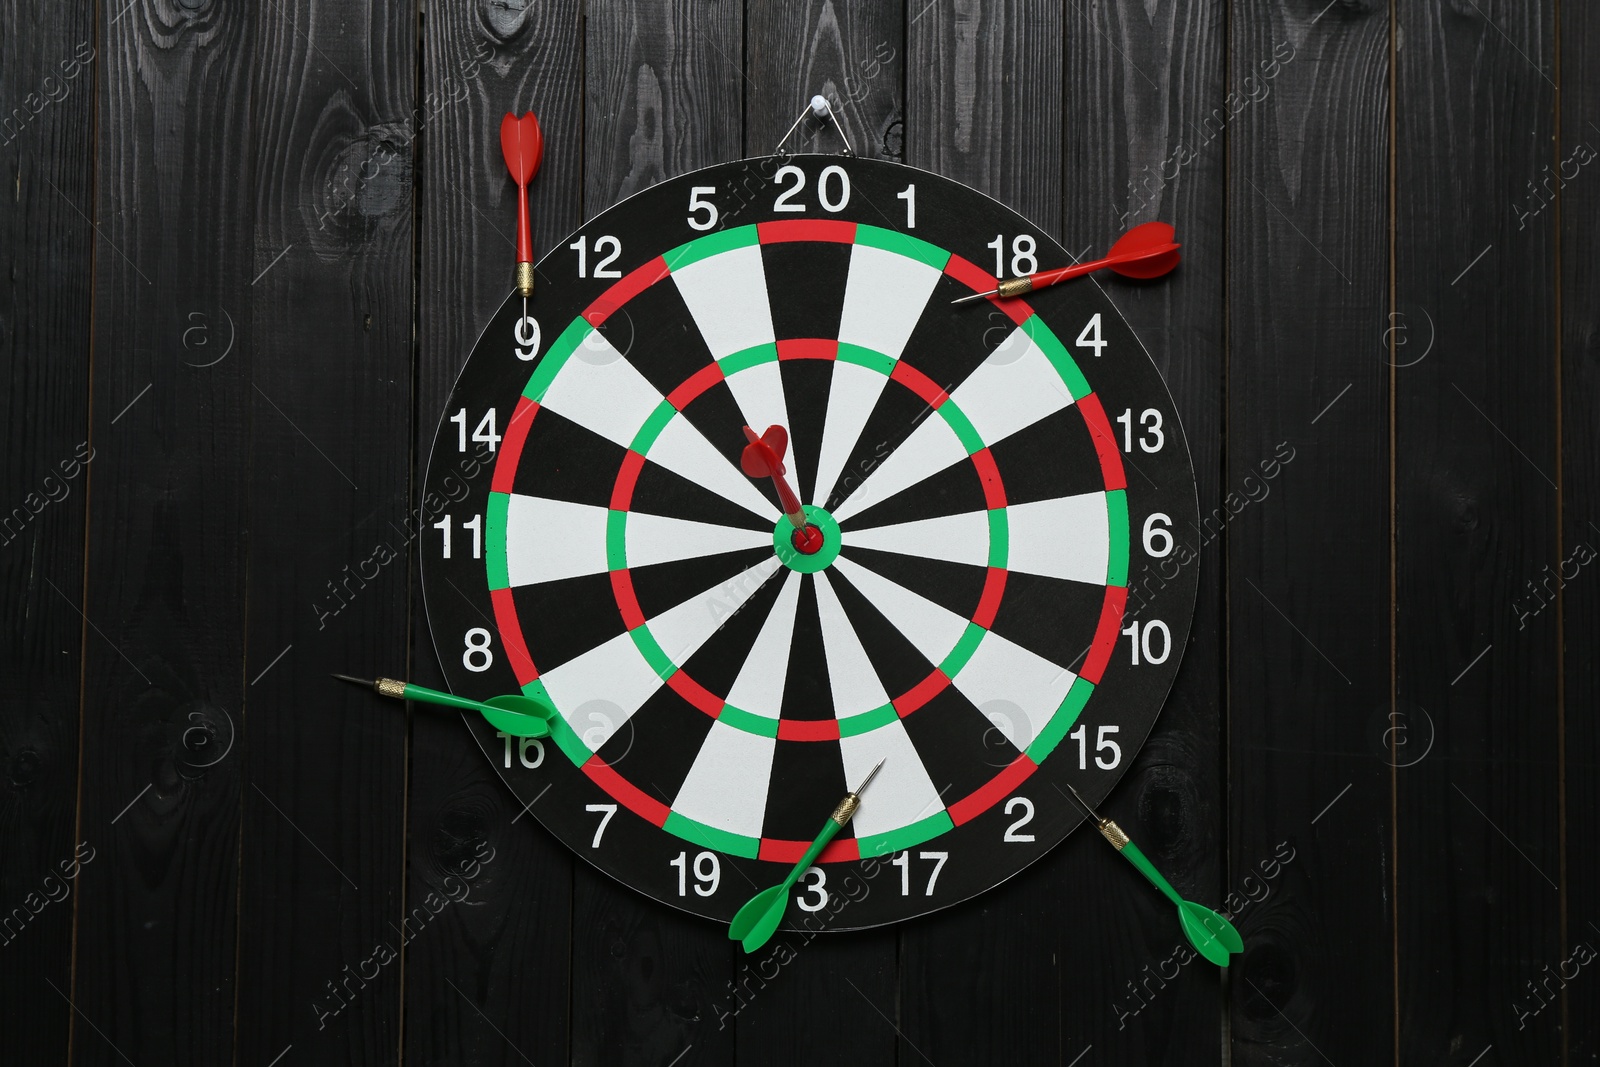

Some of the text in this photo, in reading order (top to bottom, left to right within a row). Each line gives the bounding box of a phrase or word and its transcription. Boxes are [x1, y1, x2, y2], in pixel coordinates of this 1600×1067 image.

[688, 187, 718, 230] 5
[774, 166, 850, 212] 20
[897, 184, 915, 228] 1
[570, 236, 621, 278] 12
[988, 235, 1037, 278] 18
[514, 316, 541, 361] 9
[1076, 314, 1107, 356] 4
[451, 408, 501, 452] 14
[1117, 409, 1164, 453] 13
[434, 515, 480, 558] 11
[1143, 513, 1173, 557] 6
[463, 628, 492, 672] 8
[1123, 620, 1171, 665] 10
[497, 731, 545, 769] 16
[1071, 725, 1121, 770] 15
[586, 805, 617, 848] 7
[1004, 797, 1035, 842] 2
[670, 852, 720, 896] 19
[797, 867, 828, 911] 3
[893, 851, 948, 895] 17
